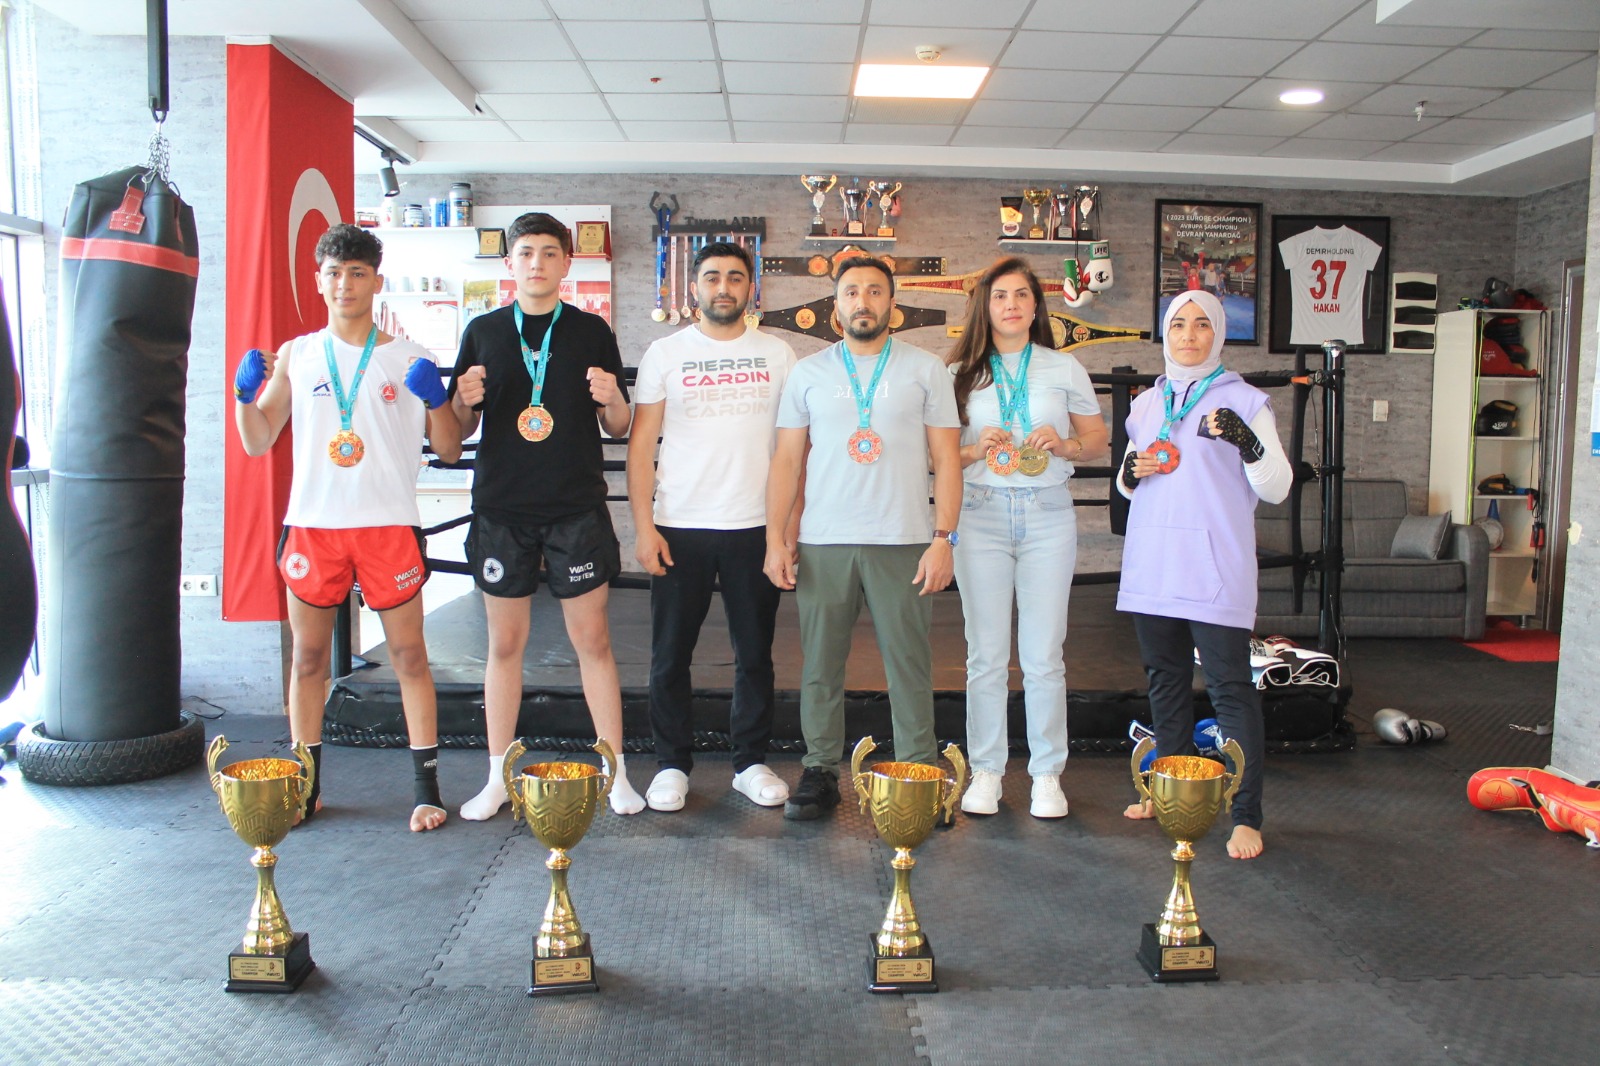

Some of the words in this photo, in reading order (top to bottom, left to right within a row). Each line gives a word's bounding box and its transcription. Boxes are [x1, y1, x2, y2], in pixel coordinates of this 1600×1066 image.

[1309, 259, 1347, 300] 37
[1313, 303, 1340, 313] HAKAN
[682, 357, 767, 373] PIERRE
[682, 371, 770, 387] CARDIN
[683, 386, 771, 404] PIERRE
[684, 401, 770, 419] CARDIN
